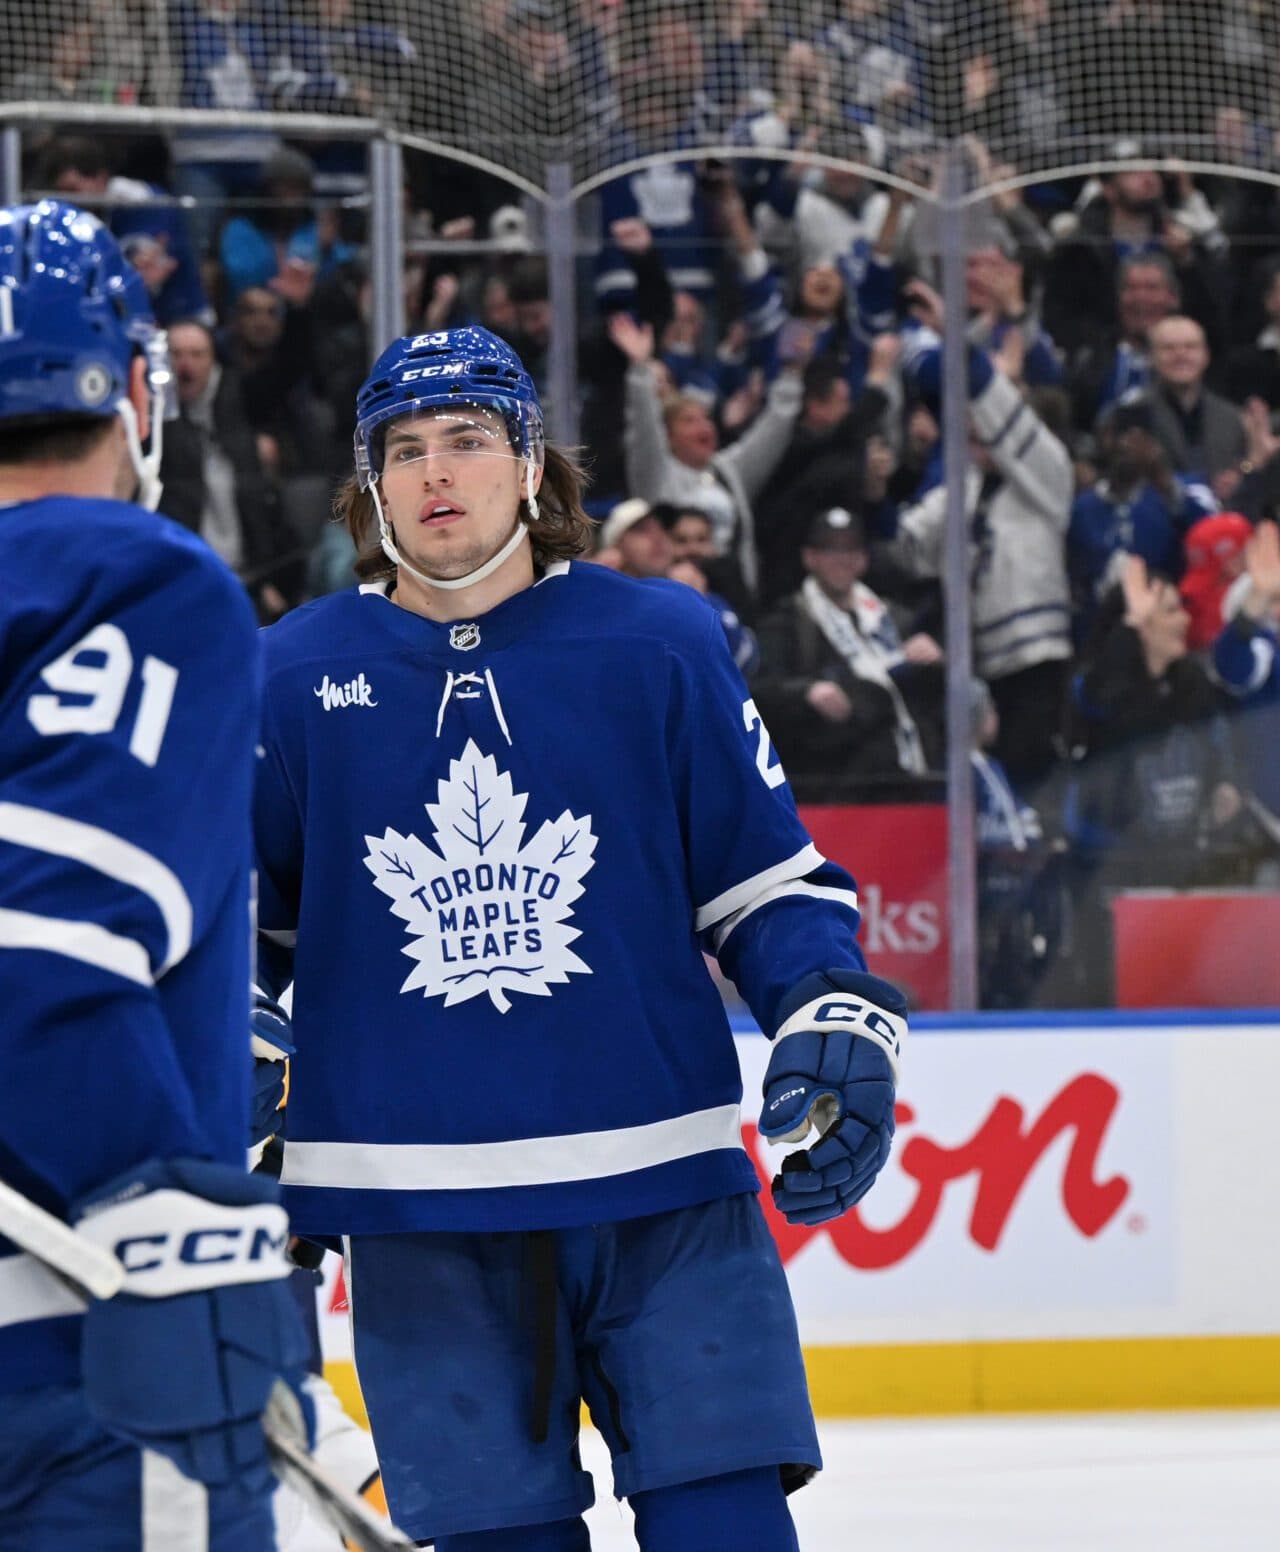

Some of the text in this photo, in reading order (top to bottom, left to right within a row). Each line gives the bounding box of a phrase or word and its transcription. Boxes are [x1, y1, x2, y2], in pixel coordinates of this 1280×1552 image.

[401, 361, 465, 382] CCM
[26, 622, 180, 769] 91
[313, 672, 378, 712] Milk
[410, 862, 561, 913] TORONTO
[437, 898, 540, 934] MAPLE
[858, 884, 940, 953] ks
[440, 928, 543, 963] LEAFS
[813, 1002, 901, 1058] CC
[769, 1086, 806, 1112] CCM
[112, 1225, 284, 1274] CCM
